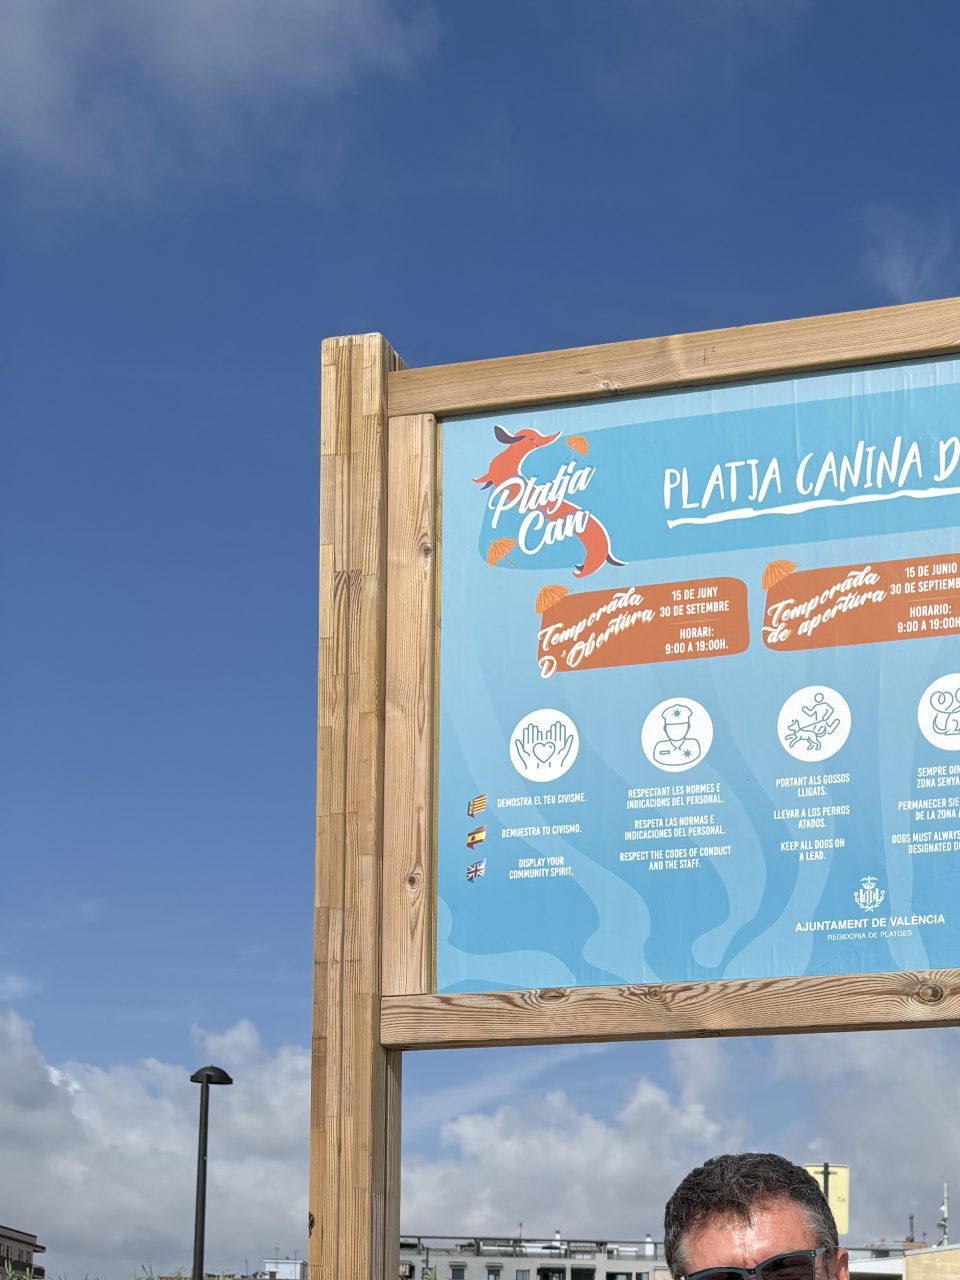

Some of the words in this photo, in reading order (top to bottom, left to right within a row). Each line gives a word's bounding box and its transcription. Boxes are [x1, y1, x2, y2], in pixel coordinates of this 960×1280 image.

[663, 458, 782, 510] PLATJA
[796, 436, 923, 497] CANINA
[488, 461, 597, 529] Platja
[518, 509, 590, 555] Can
[905, 567, 915, 578] 15
[918, 565, 929, 577] DE
[932, 562, 957, 576] JUNIO
[672, 590, 681, 601] 15
[684, 589, 694, 600] DE
[697, 587, 718, 599] JUNY
[890, 583, 901, 595] 30
[904, 582, 916, 594] DE
[768, 566, 880, 627] Temporada
[660, 606, 671, 618] 30
[673, 605, 684, 616] DE
[686, 601, 729, 615] SETEMBRE
[762, 623, 791, 643] de
[797, 588, 887, 636] apertura
[910, 603, 952, 618] HORARIO:
[538, 587, 644, 651] Temporada
[680, 626, 714, 640] HORARI:
[898, 621, 918, 633] 9:00
[921, 620, 927, 631] A
[665, 642, 685, 654] 9:00
[687, 642, 693, 653] A
[696, 639, 728, 651] 19:00H.
[918, 766, 947, 777] SEMPRE
[776, 777, 807, 787] PORTANT
[809, 776, 821, 785] ALS
[823, 773, 850, 784] GOSSOS
[917, 778, 936, 788] ZONA
[628, 787, 670, 798] RESPECTANT
[672, 786, 684, 795] LES
[686, 784, 714, 794] NORMES
[716, 783, 720, 792] E
[798, 786, 827, 797] LLIGATS.
[497, 797, 532, 808] DEMOSTRA
[534, 796, 542, 804] EL
[544, 795, 555, 804] TEU
[558, 793, 586, 803] CIVISME.
[627, 799, 670, 809] INDICACIONS
[672, 798, 684, 806] DEL
[686, 794, 724, 805] PERSONAL.
[898, 799, 946, 811] PERMANECER
[774, 809, 799, 819] LLEVAR
[801, 809, 806, 817] A
[808, 808, 820, 817] LOS
[823, 805, 850, 816] PERROS
[916, 812, 924, 820] DE
[927, 811, 935, 819] LA
[937, 810, 956, 819] ZONA
[634, 818, 663, 829] RESPETA
[666, 818, 677, 826] LAS
[680, 816, 708, 825] NORMAS
[710, 815, 714, 824] E
[798, 818, 826, 829] ATADOS.
[502, 828, 540, 838] DEMUESTRA
[542, 826, 550, 835] TU
[552, 824, 582, 834] CIVISMO.
[625, 828, 672, 840] INDICACIONES
[674, 827, 686, 837] DEL
[688, 825, 726, 836] PERSONAL.
[892, 834, 911, 844] DOGS
[913, 832, 932, 842] MUST
[934, 831, 960, 841] ALWAYS
[781, 842, 798, 851] KEEP
[801, 841, 813, 850] ALL
[815, 839, 833, 849] DOGS
[835, 838, 844, 847] ON
[908, 842, 951, 854] DESIGNATED
[620, 851, 648, 861] RESPECT
[650, 850, 663, 859] THE
[666, 848, 687, 858] CODES
[689, 848, 697, 856] OF
[700, 846, 731, 856] CONDUCT
[799, 852, 804, 861] A
[806, 851, 825, 860] LEAD.
[519, 858, 545, 868] DISPLAY
[547, 857, 564, 866] YOUR
[649, 861, 663, 871] AND
[665, 860, 678, 869] THE
[680, 859, 701, 868] STAFF.
[509, 868, 549, 879] COMMUNITY
[551, 867, 573, 876] SPIRIT.
[795, 918, 868, 932] AJUNTAMENT
[872, 917, 886, 928] DE
[880, 930, 912, 938] PLATGES
